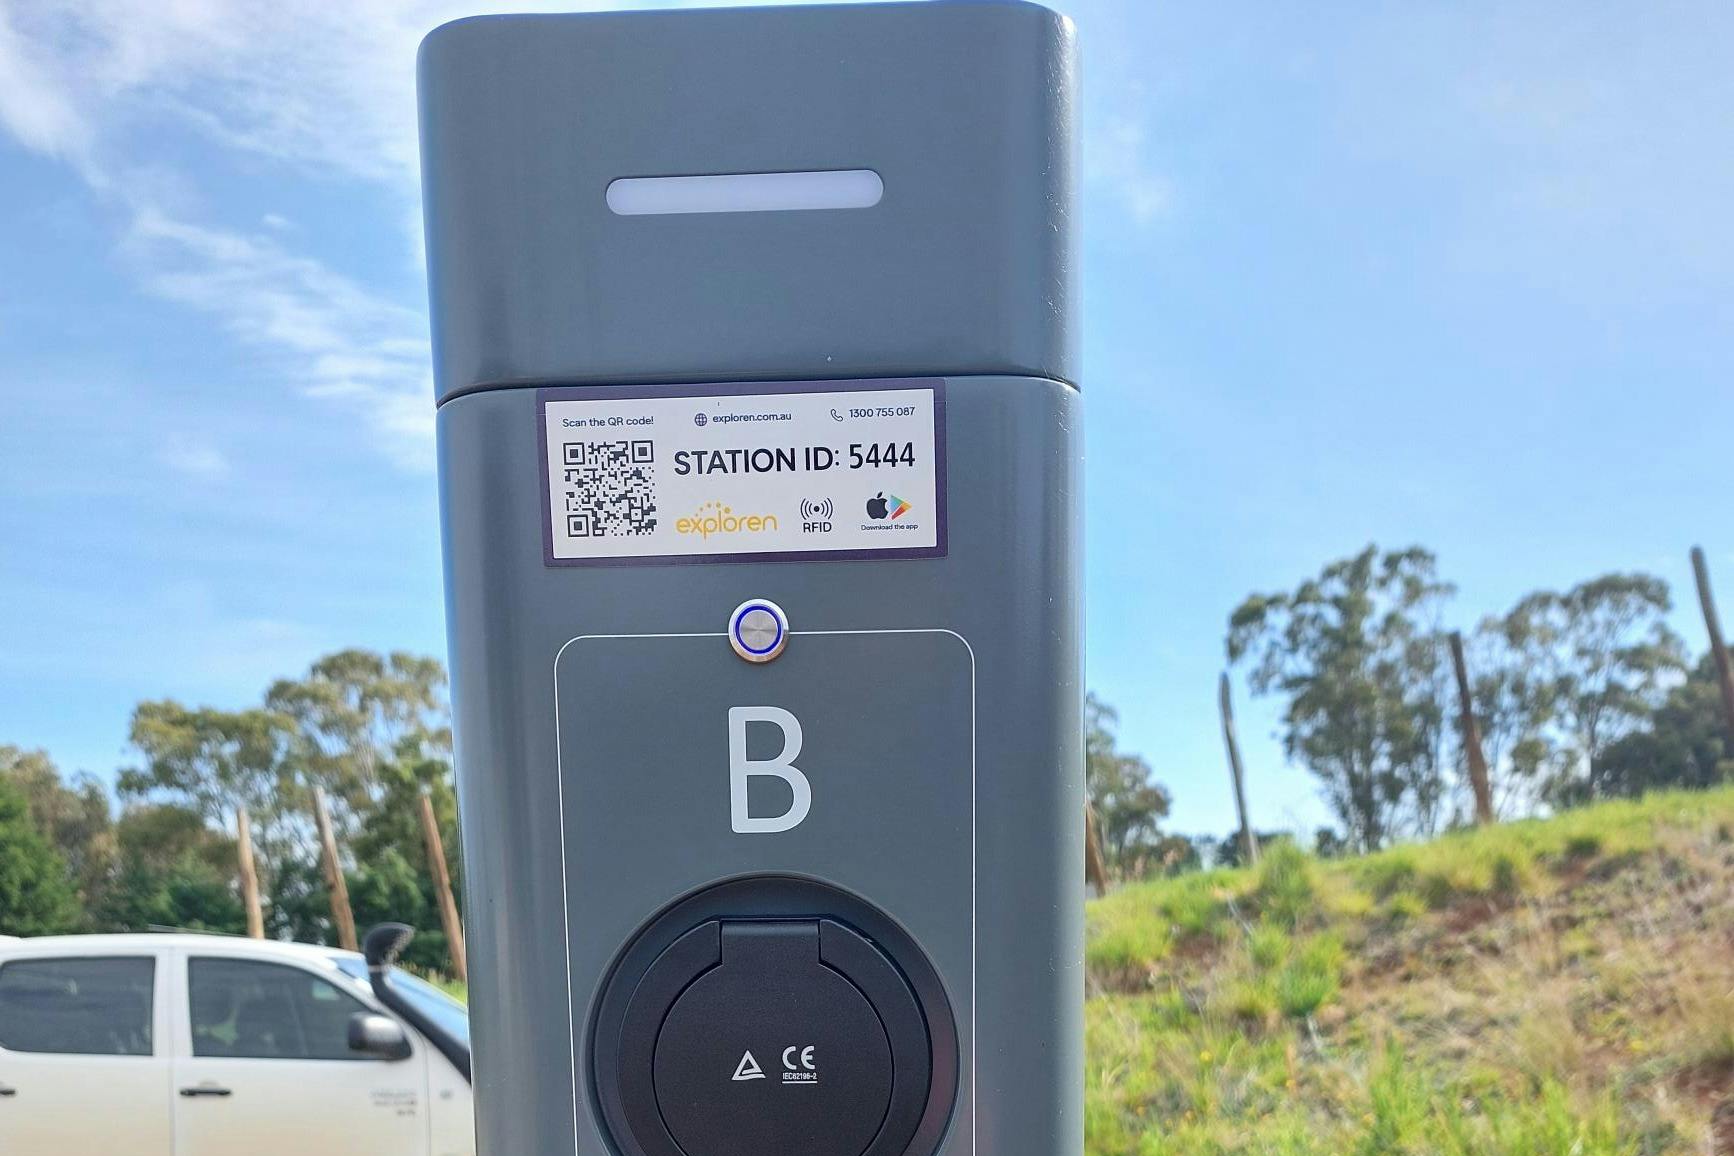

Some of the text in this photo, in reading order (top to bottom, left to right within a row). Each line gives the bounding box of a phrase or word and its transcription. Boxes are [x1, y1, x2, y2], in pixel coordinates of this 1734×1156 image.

[712, 412, 792, 424] exploren.com.au
[849, 406, 915, 418] 1300 755 087
[562, 416, 654, 428] Scan the QR code!
[674, 442, 915, 475] STATION ID: 5444
[675, 509, 778, 540] exploren
[803, 522, 832, 533] RFID
[907, 524, 919, 532] app
[728, 706, 812, 833] B
[782, 1046, 815, 1070] CE
